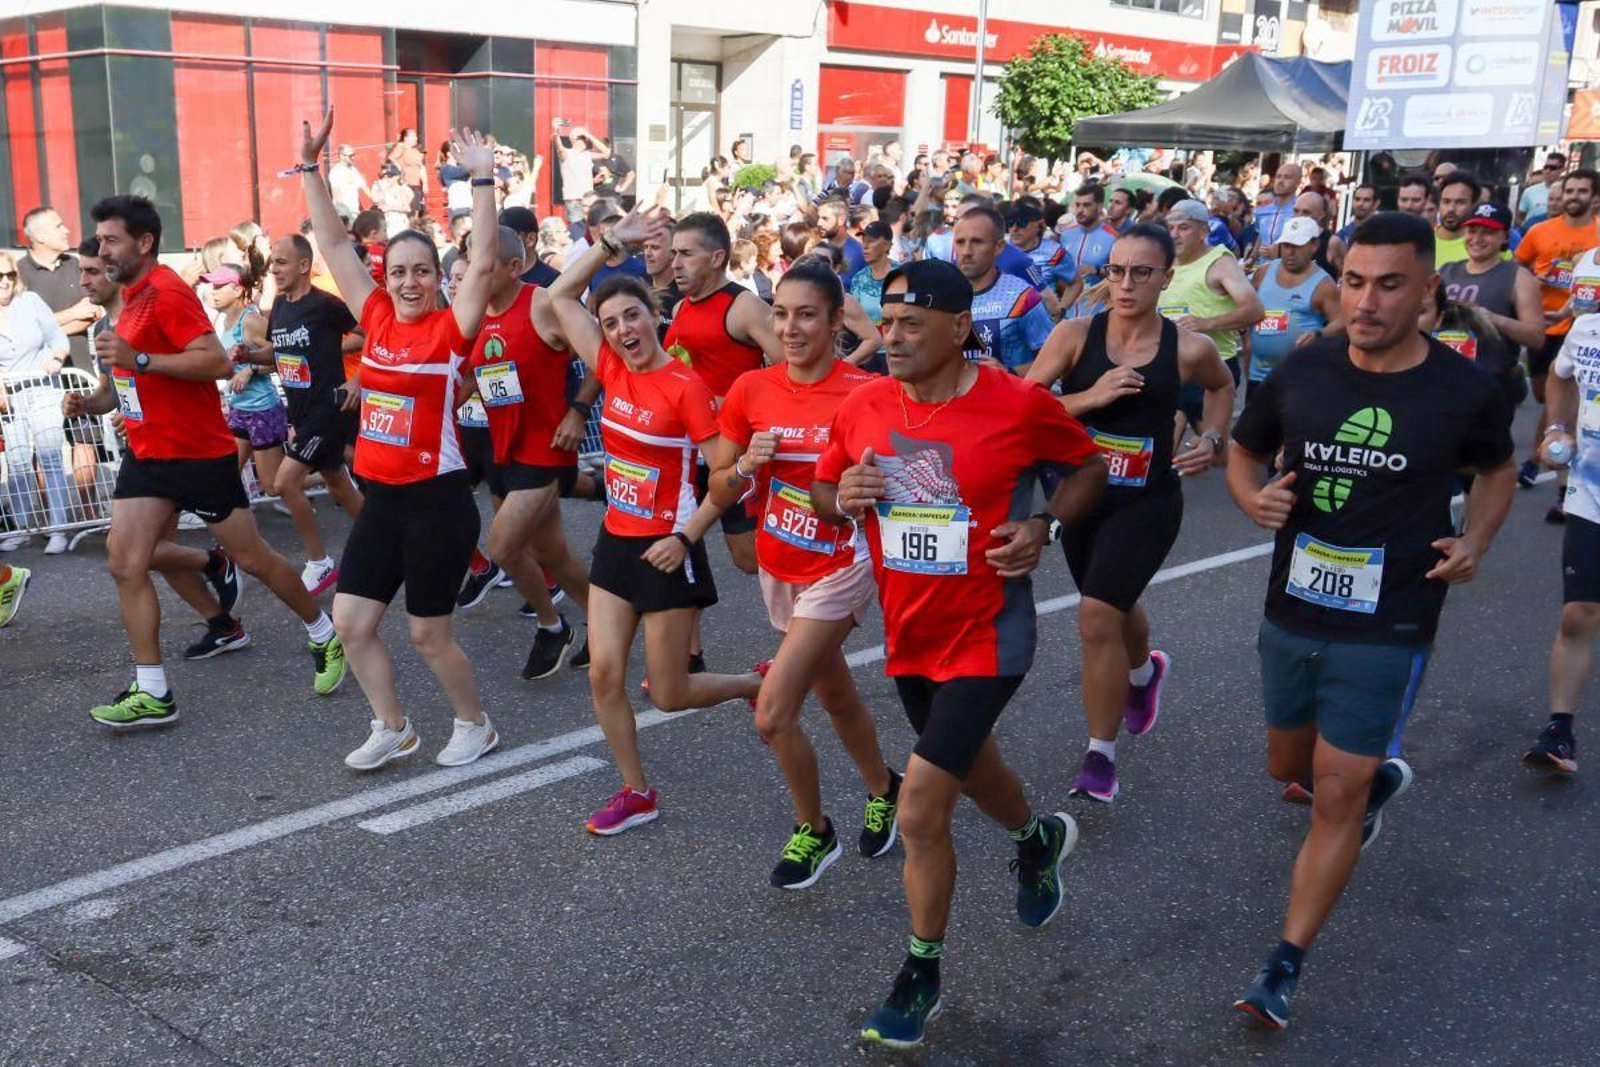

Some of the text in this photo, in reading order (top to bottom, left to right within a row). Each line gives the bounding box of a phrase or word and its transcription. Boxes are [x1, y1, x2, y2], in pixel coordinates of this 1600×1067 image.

[1390, 0, 1437, 16] PIZZA
[1106, 42, 1153, 65] Santander
[1377, 52, 1439, 76] FROIZ
[612, 396, 635, 416] FROIZ
[369, 411, 394, 434] 927
[1304, 441, 1408, 472] KALEIDO
[1331, 466, 1368, 477] LOGISTICS
[612, 478, 638, 506] 925
[781, 508, 819, 541] 926
[901, 531, 938, 562] 196
[1308, 566, 1354, 598] 208
